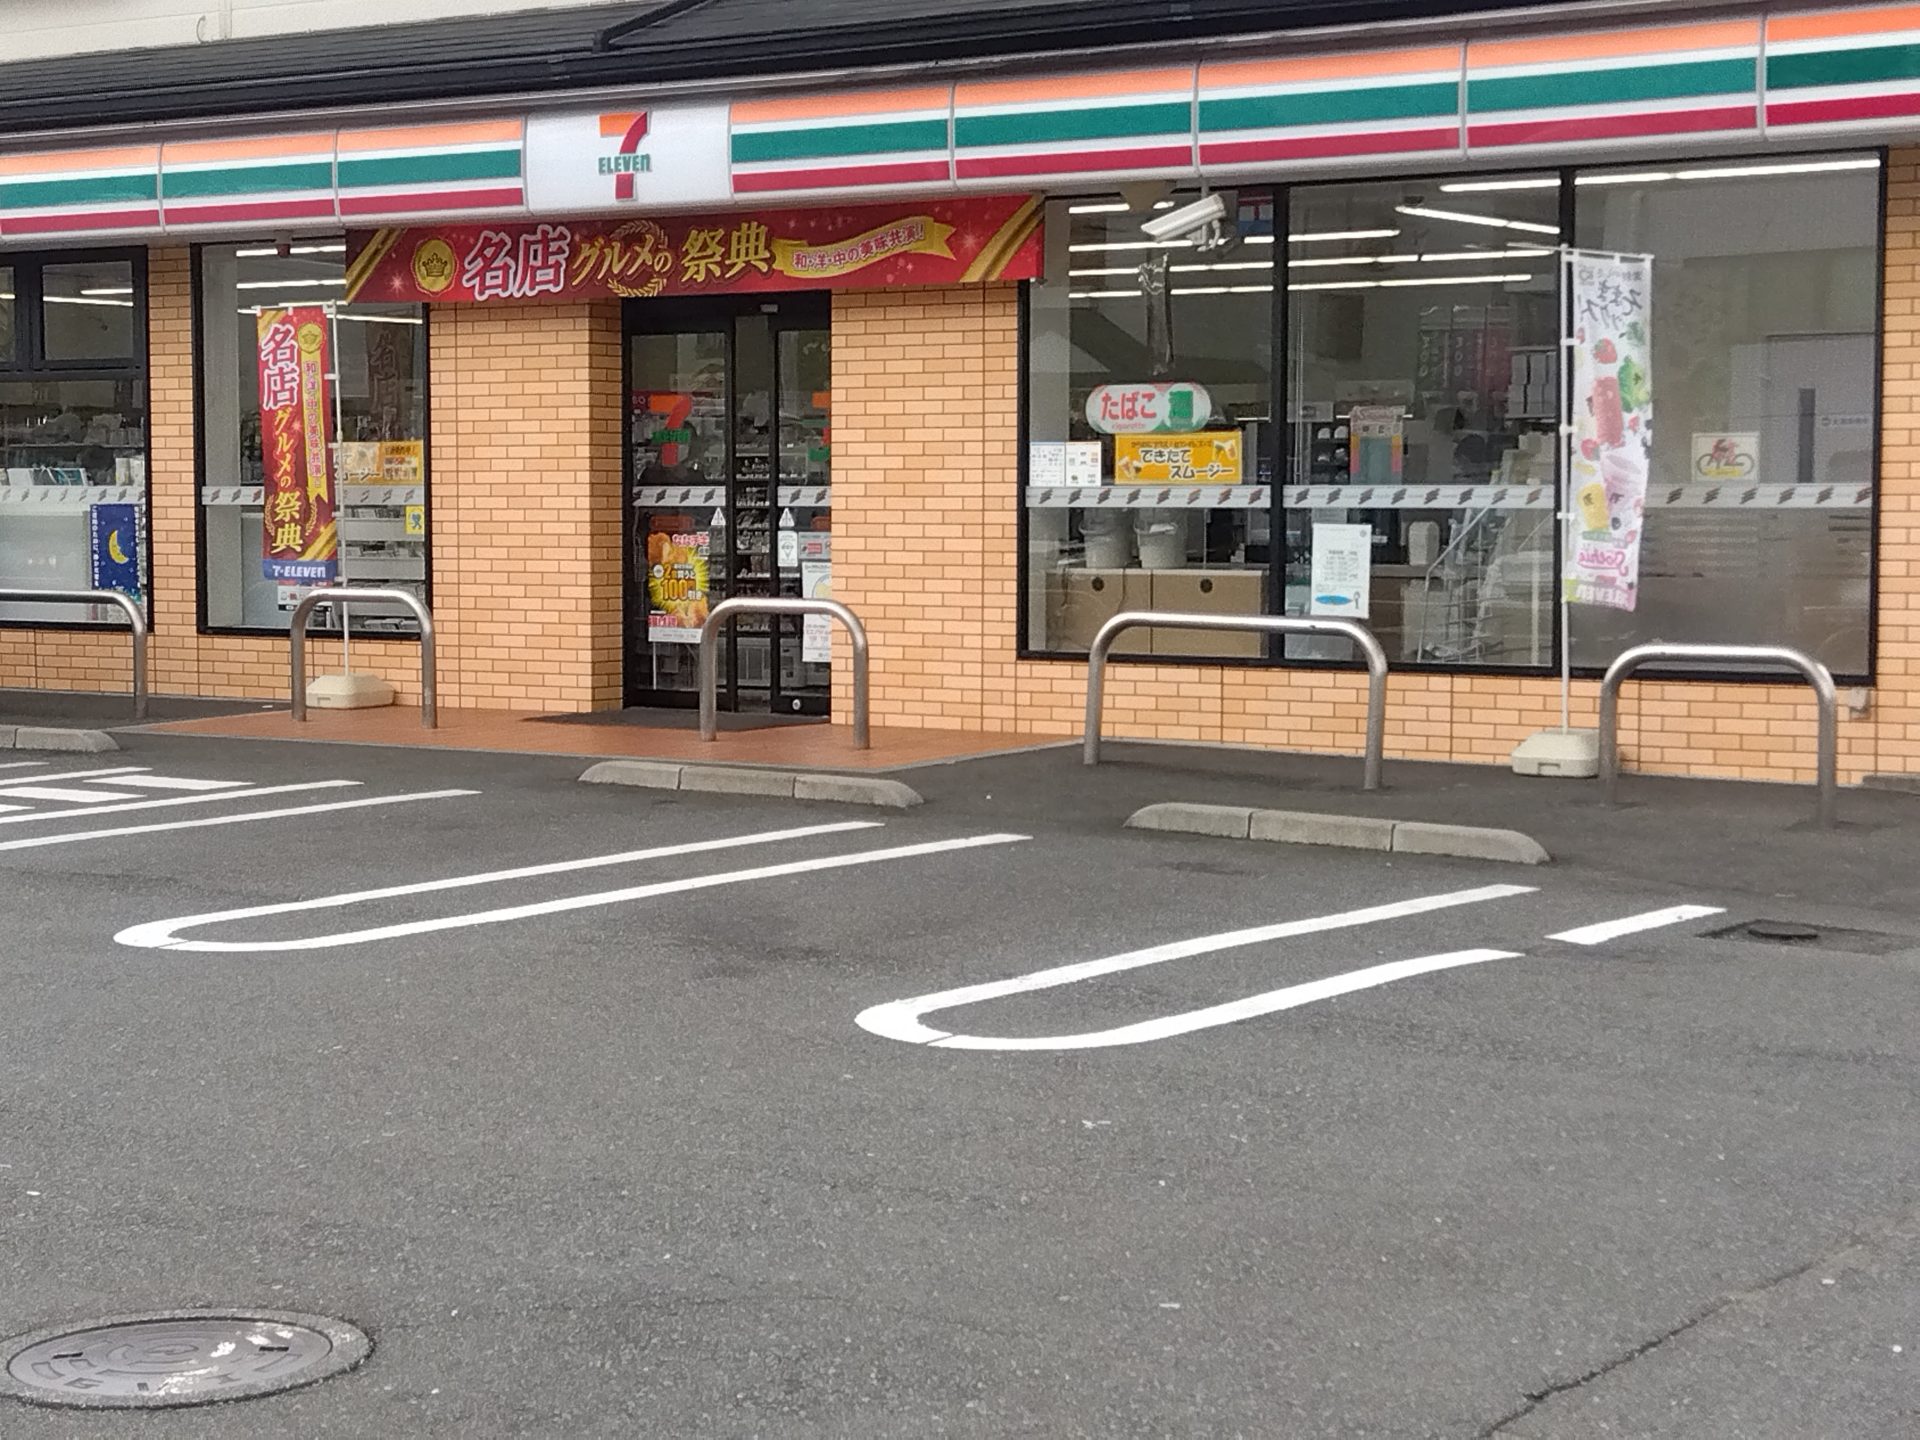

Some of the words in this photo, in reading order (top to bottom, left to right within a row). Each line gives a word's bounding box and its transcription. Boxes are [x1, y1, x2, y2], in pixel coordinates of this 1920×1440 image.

[1101, 392, 1157, 421] たばこ
[1140, 449, 1192, 464] できたて
[1170, 464, 1234, 480] スムージー
